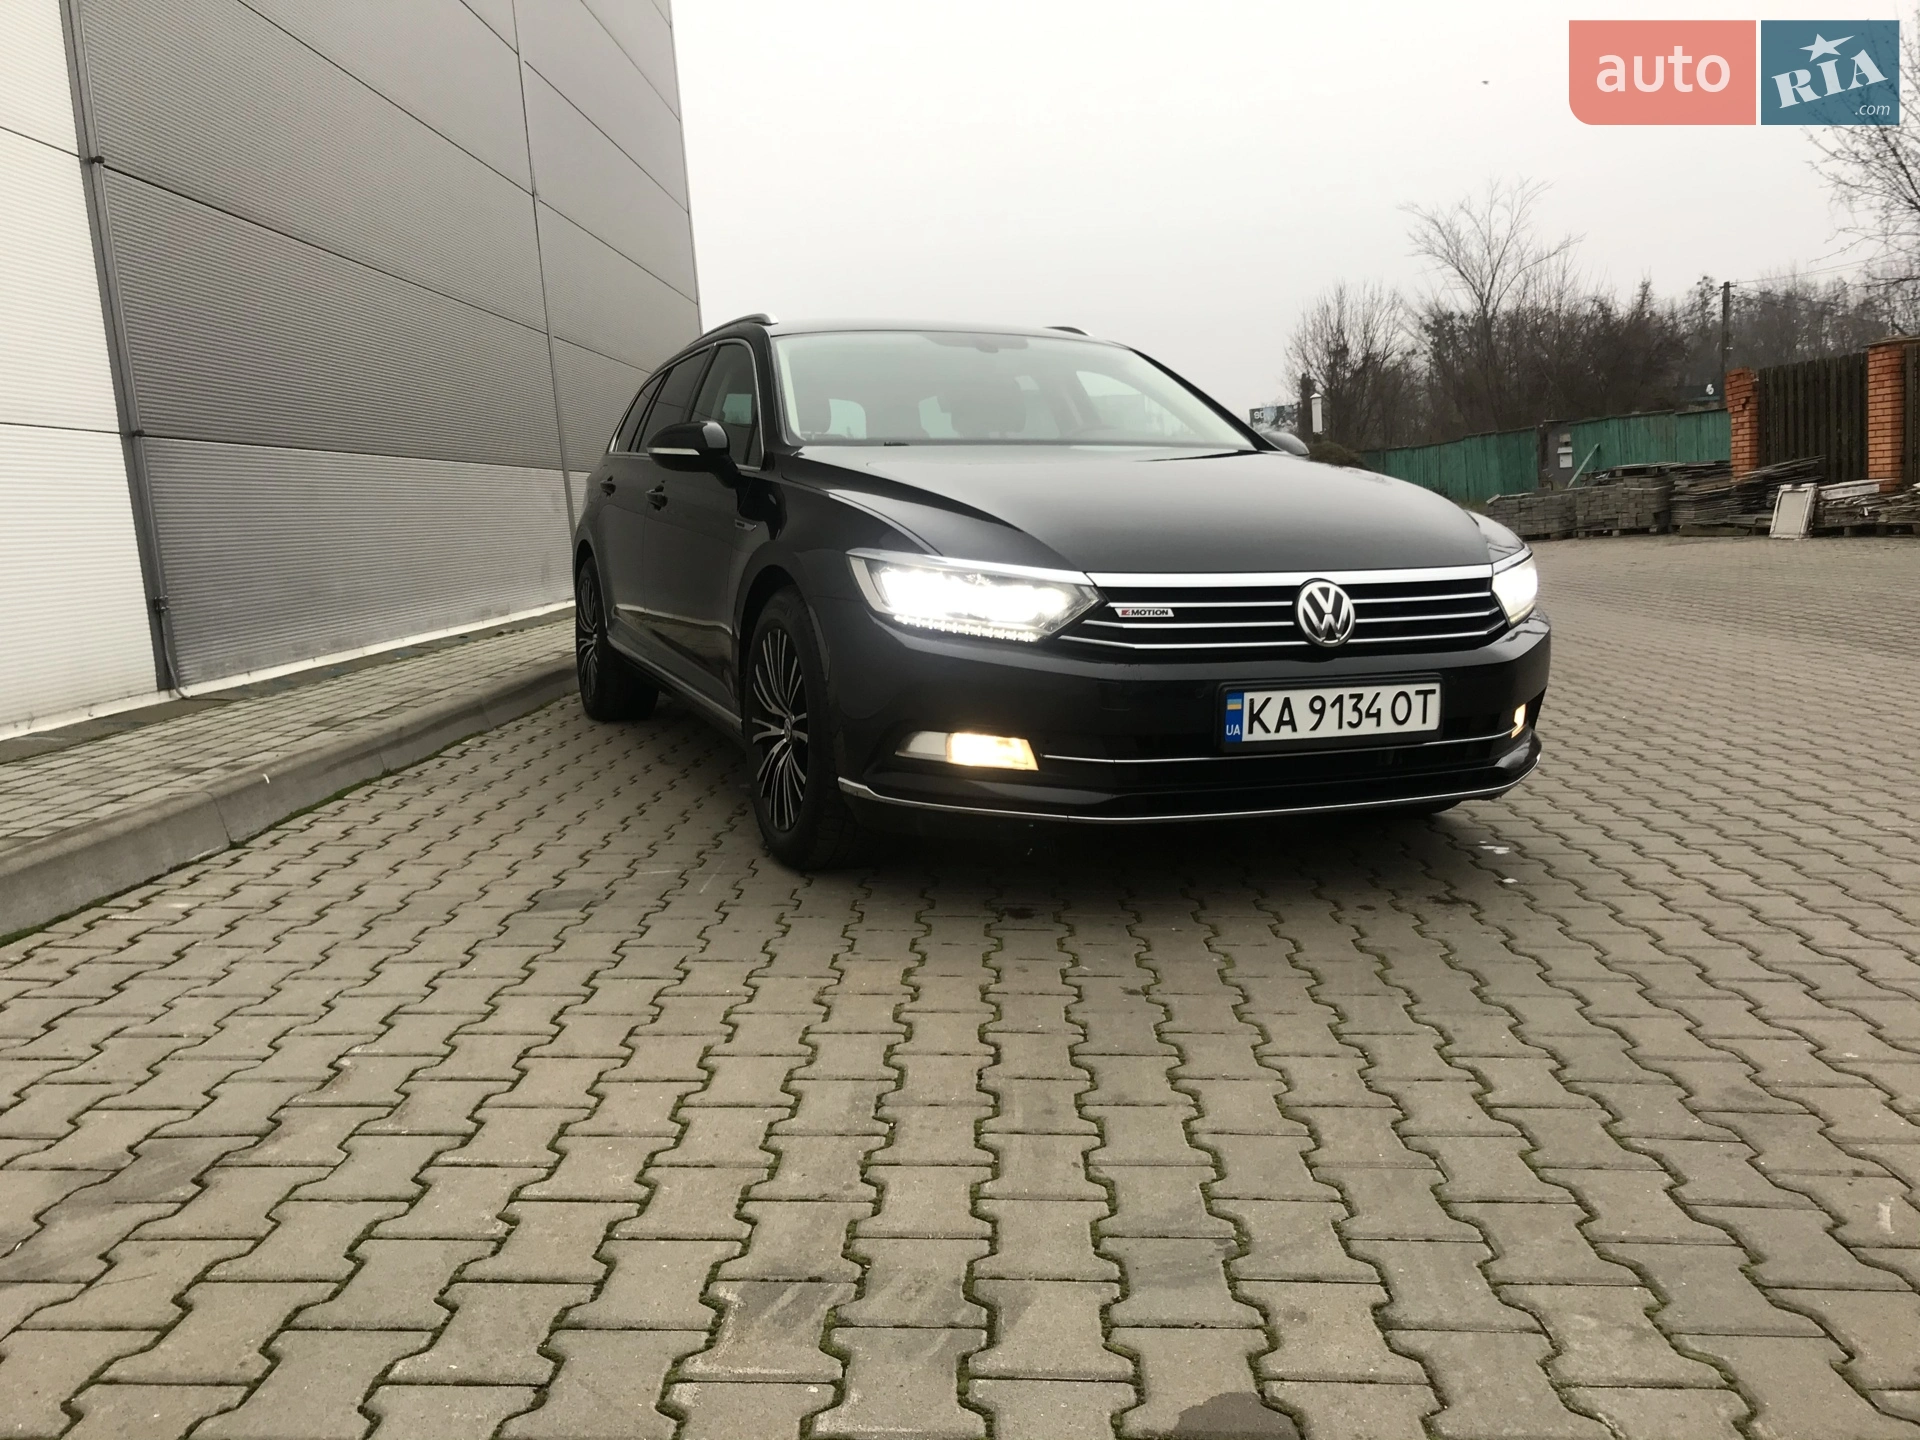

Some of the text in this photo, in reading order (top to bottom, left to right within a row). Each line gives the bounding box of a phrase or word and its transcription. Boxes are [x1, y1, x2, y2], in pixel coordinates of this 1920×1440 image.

[1248, 689, 1437, 735] KA 9134 OT
[1226, 724, 1241, 736] UA
